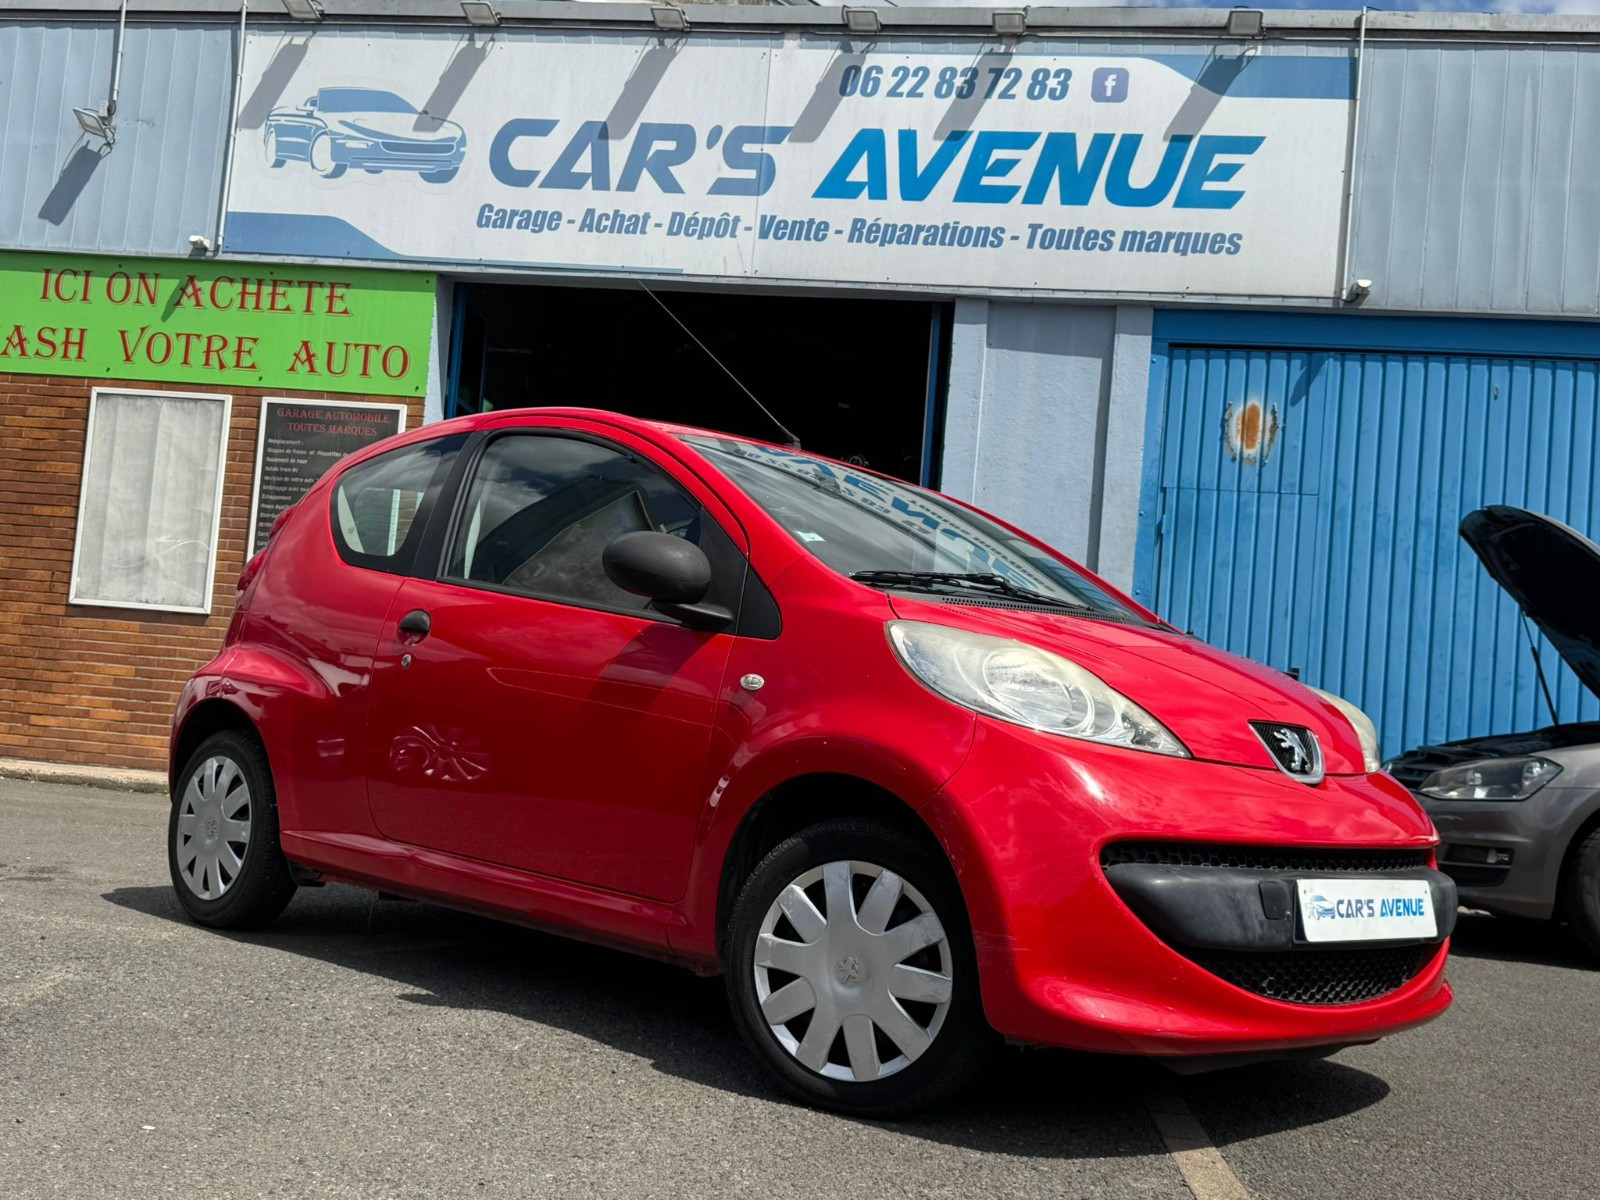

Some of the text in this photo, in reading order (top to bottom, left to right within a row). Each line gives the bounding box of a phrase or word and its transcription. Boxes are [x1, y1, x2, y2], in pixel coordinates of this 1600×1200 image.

[839, 65, 1072, 100] 06 22 83 72 83
[489, 118, 1267, 209] CAR'S AVENUE
[476, 203, 562, 234] Garage
[578, 208, 651, 235] Achat
[666, 210, 741, 240] Dépôt
[758, 214, 828, 242] Vente
[848, 217, 1005, 248] Réparations
[1027, 222, 1115, 252] Toutes
[1119, 230, 1243, 256] marques
[40, 268, 352, 317] ICI ON ACHETE
[118, 324, 260, 373] VOTRE
[287, 340, 410, 380] AUTO
[277, 408, 390, 424] GARAGE AUTOMOBILE
[288, 422, 377, 436] TOUTES MARQUES
[1336, 898, 1425, 918] CAR'S AVENUE
